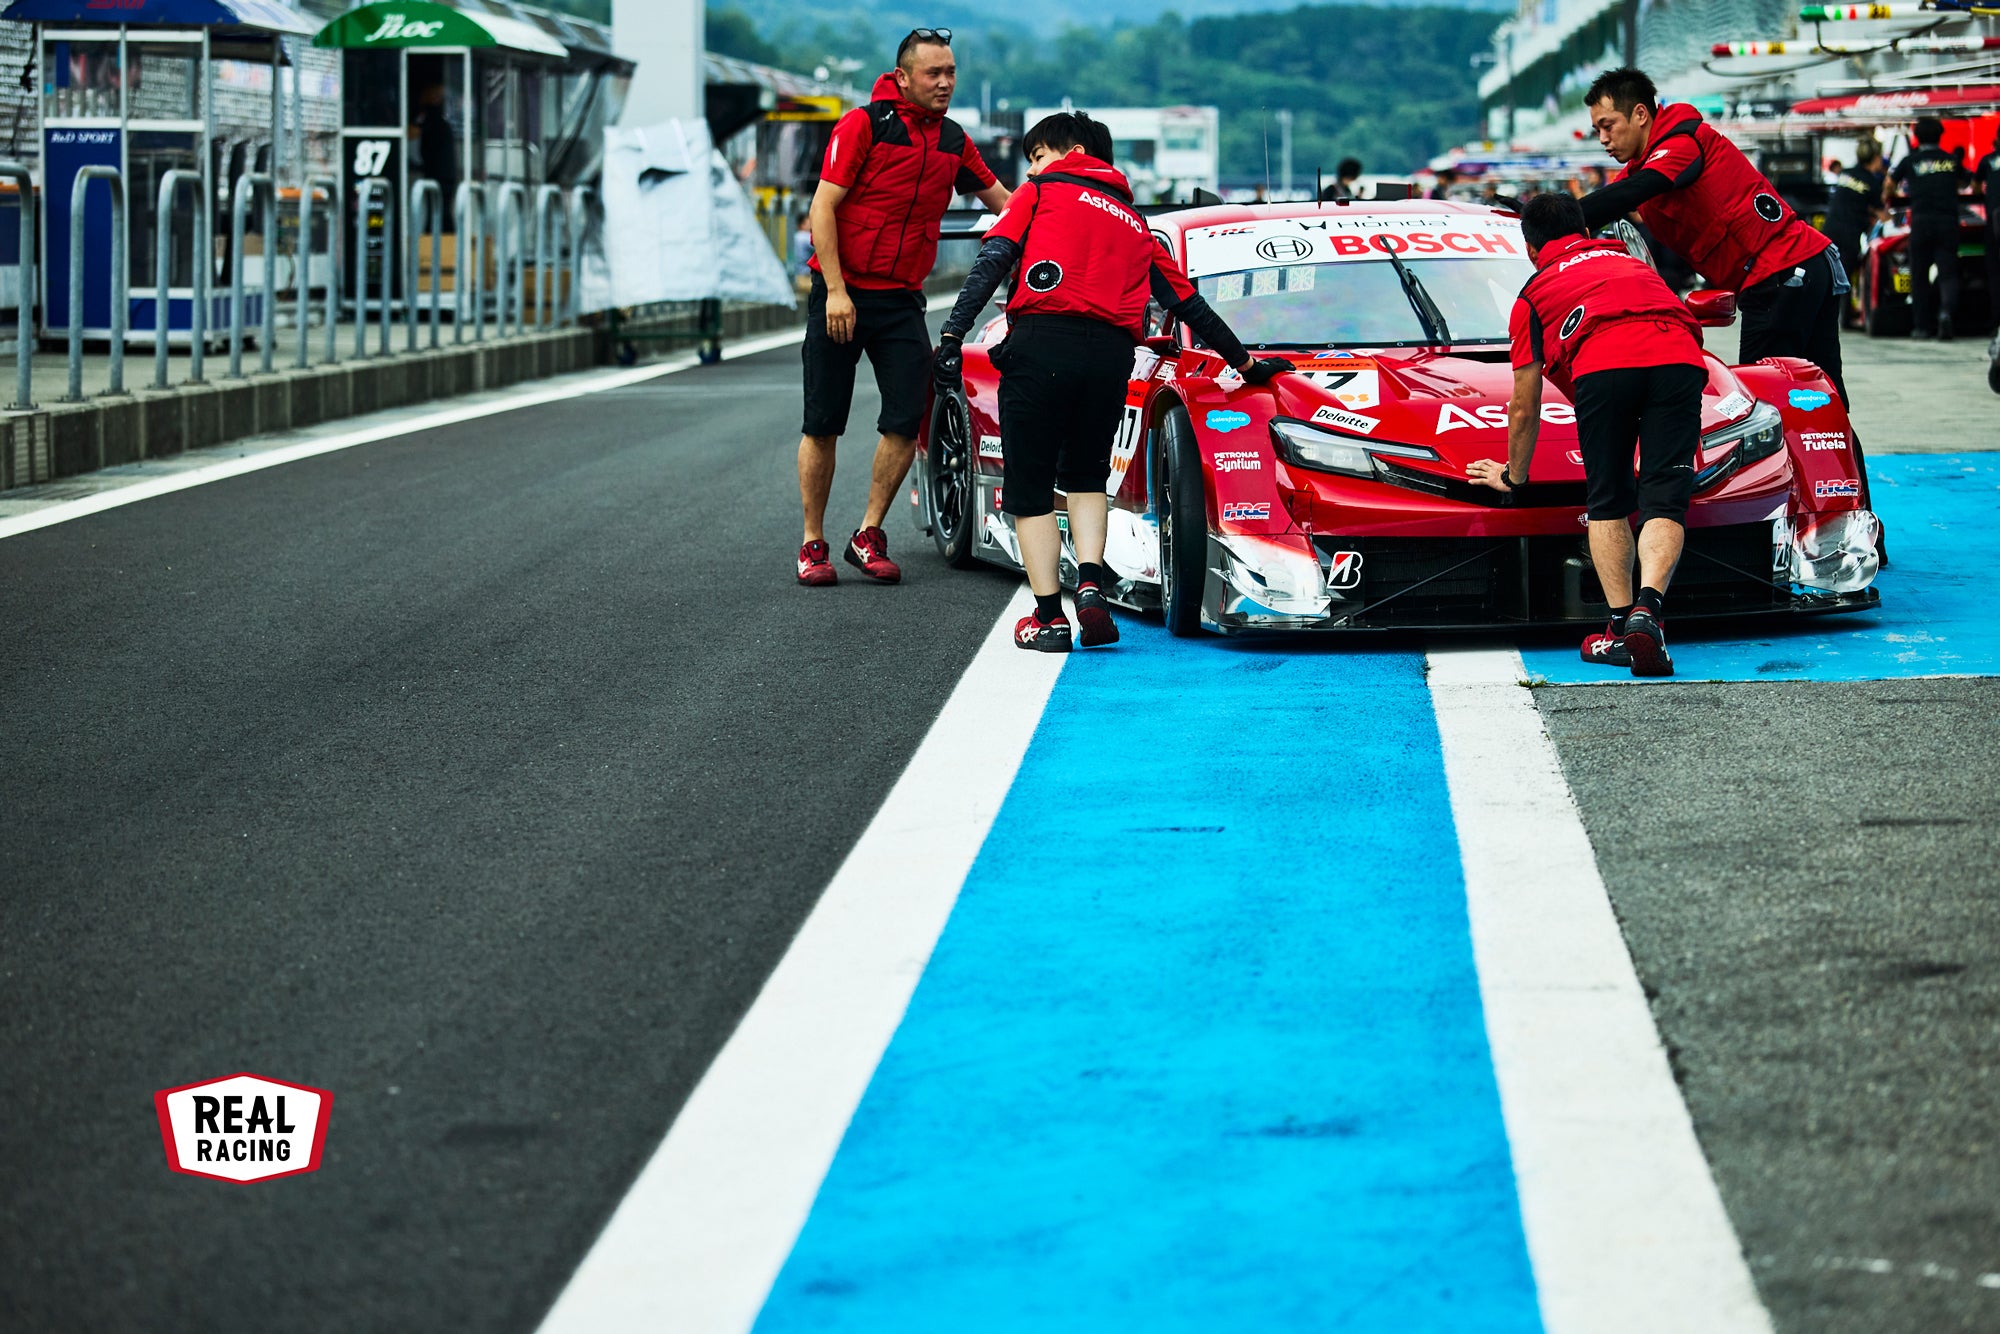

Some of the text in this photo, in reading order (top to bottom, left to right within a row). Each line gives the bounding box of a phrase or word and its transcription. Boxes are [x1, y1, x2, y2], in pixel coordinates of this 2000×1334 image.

[354, 140, 391, 176] 87
[1078, 191, 1143, 233] Astemo
[1338, 219, 1448, 228] Honda
[1329, 232, 1519, 255] BOSCH
[1801, 432, 1844, 440] PETRONAS
[1803, 439, 1846, 451] Tutela
[1216, 459, 1260, 472] Syntium
[1815, 479, 1858, 494] HRC
[1223, 502, 1270, 518] HRC
